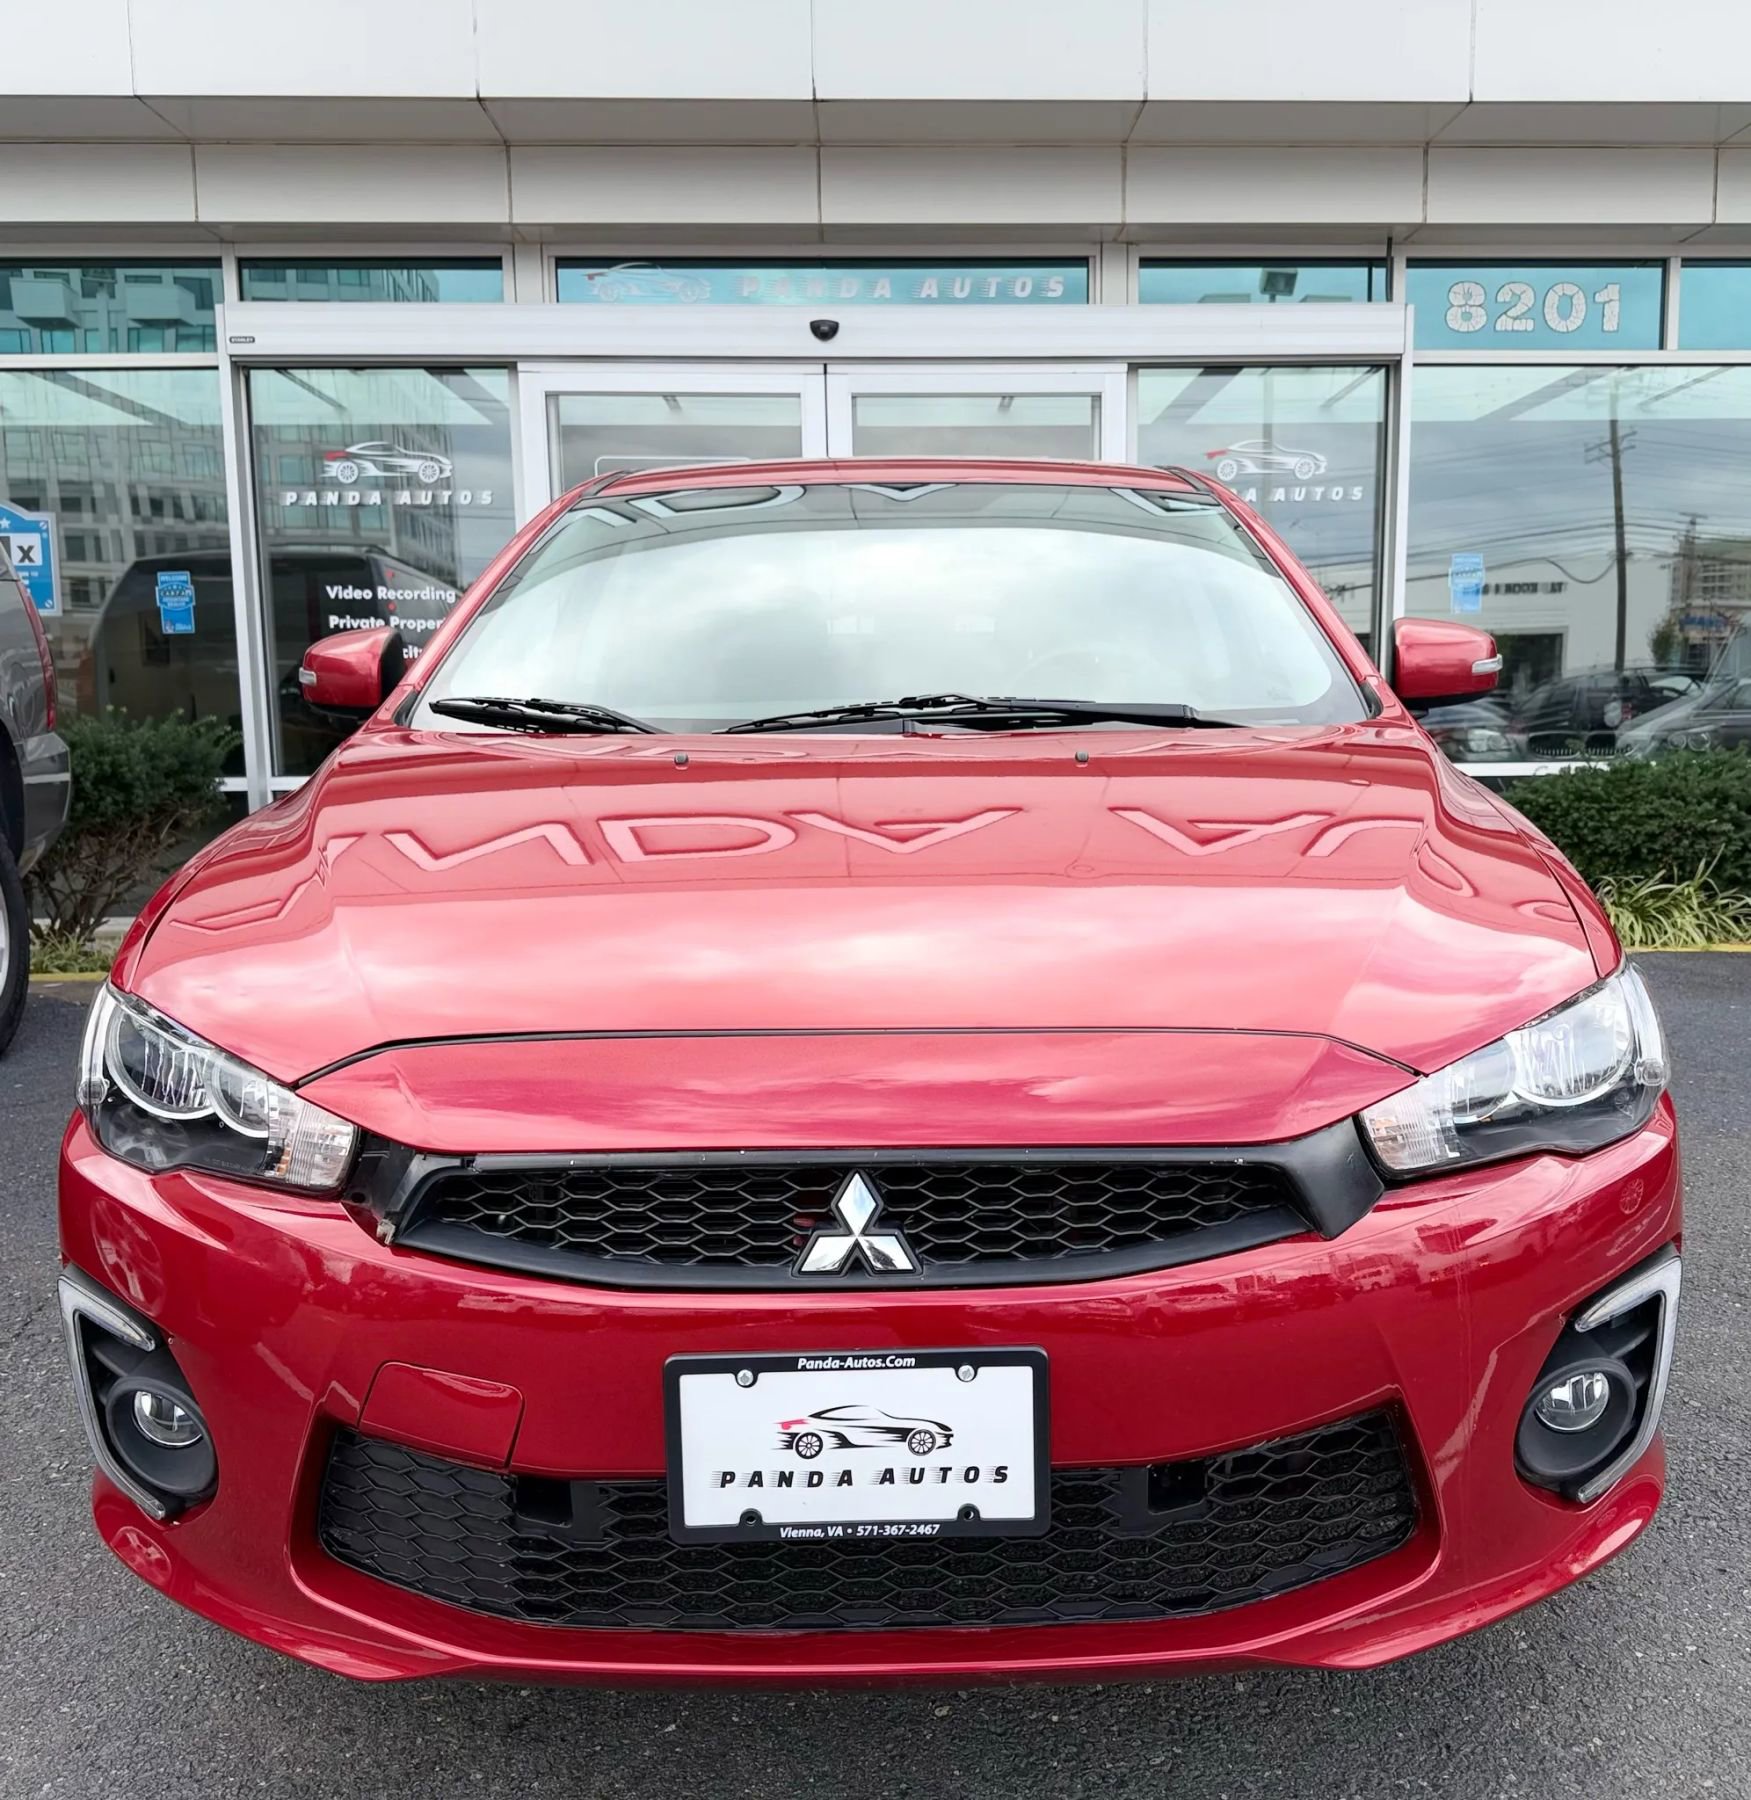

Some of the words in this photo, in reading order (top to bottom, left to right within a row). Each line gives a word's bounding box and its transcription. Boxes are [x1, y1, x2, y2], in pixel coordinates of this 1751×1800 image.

[738, 276, 892, 299] PANDA
[918, 275, 1065, 299] AUTOS
[1445, 280, 1621, 334] 8201
[281, 490, 382, 507] PANDA
[397, 489, 494, 506] AUTOS
[1270, 485, 1364, 503] AUTOS
[325, 584, 373, 601] Video
[376, 585, 457, 604] Recording
[328, 614, 386, 630] Private
[389, 615, 447, 633] Proper
[797, 1355, 916, 1370] Panda-Autos.Com
[714, 1468, 854, 1488] PANDA
[873, 1465, 1008, 1485] AUTOS
[779, 1526, 825, 1539] Vienna,
[827, 1525, 844, 1537] VA
[856, 1523, 941, 1537] 571-367-2467
